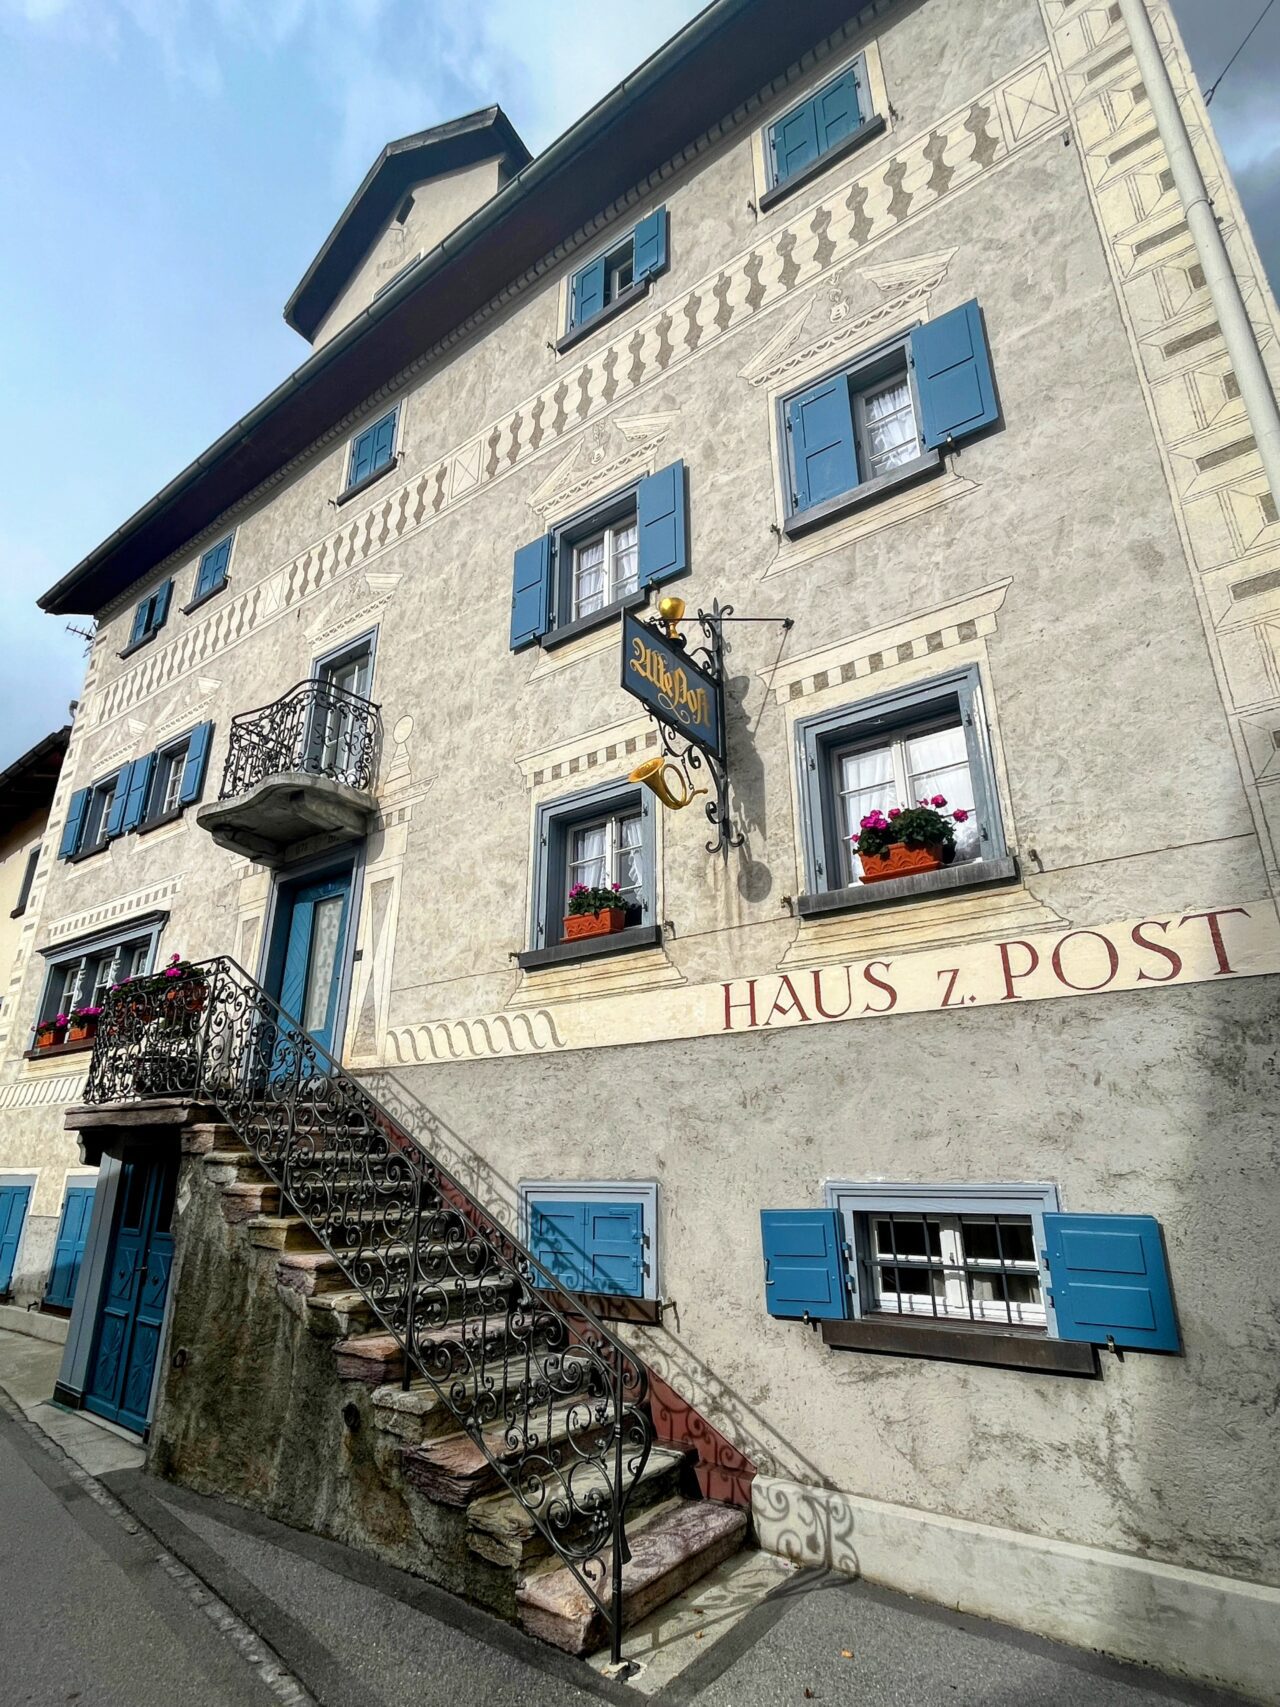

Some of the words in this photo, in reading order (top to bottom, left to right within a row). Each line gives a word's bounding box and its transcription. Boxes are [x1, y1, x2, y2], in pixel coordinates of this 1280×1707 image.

[630, 637, 673, 697] Alte
[721, 961, 899, 1031] HAUS
[994, 907, 1252, 1001] POST
